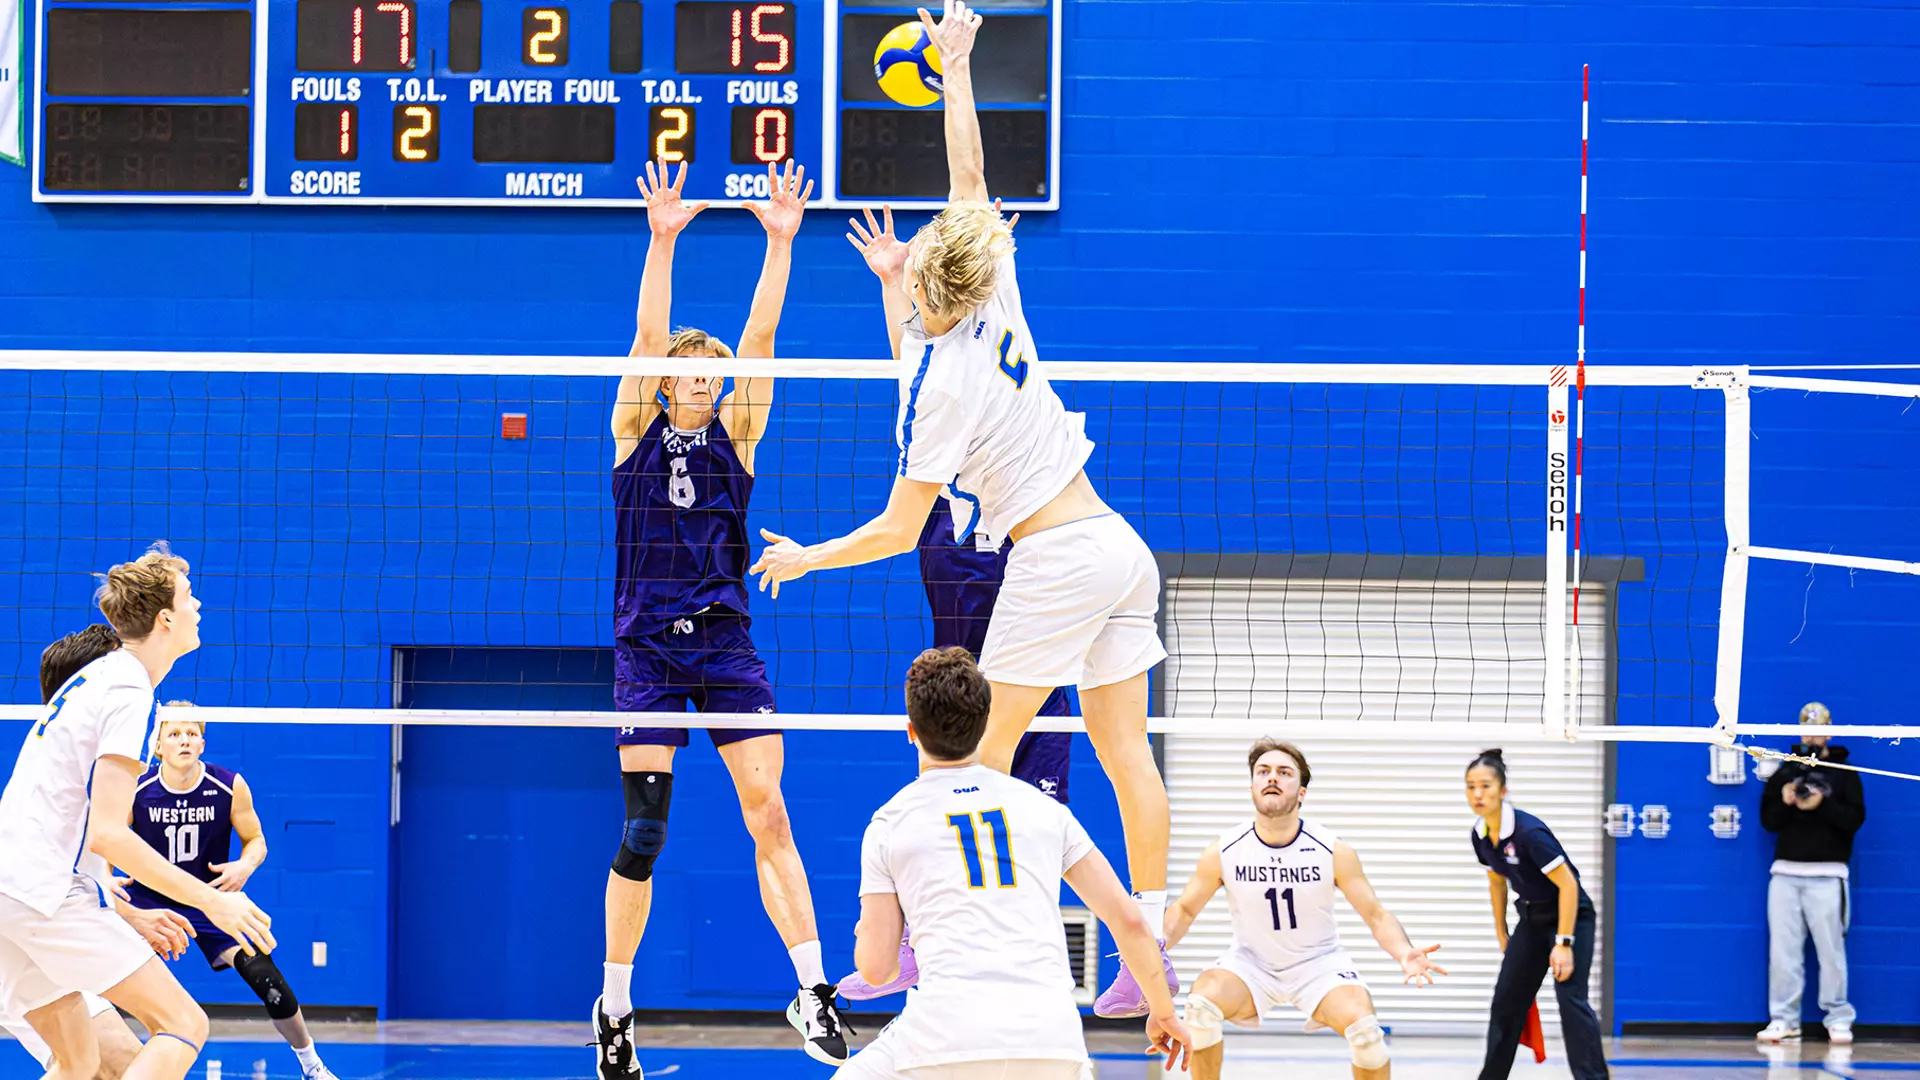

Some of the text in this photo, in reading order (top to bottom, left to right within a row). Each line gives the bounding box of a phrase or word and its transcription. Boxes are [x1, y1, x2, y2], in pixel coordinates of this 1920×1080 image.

[351, 2, 409, 65] 17
[529, 9, 562, 63] 2
[729, 4, 790, 72] 15
[291, 77, 361, 102] FOULS
[387, 78, 447, 102] T.O.L.
[469, 79, 621, 103] PLAYER FOUL
[642, 79, 703, 103] T.O.L.
[727, 80, 799, 104] FOULS
[339, 109, 351, 155] 1
[400, 107, 432, 160] 2
[656, 108, 688, 161] 2
[754, 108, 787, 162] 0
[290, 171, 361, 196] SCORE
[505, 173, 583, 197] MATCH
[668, 456, 696, 509] 6
[1549, 452, 1565, 532] Senoh
[148, 805, 215, 823] WESTERN
[164, 824, 200, 864] 10
[945, 806, 1018, 890] 11
[1235, 864, 1321, 883] MUSTANGS
[1264, 887, 1298, 931] 11
